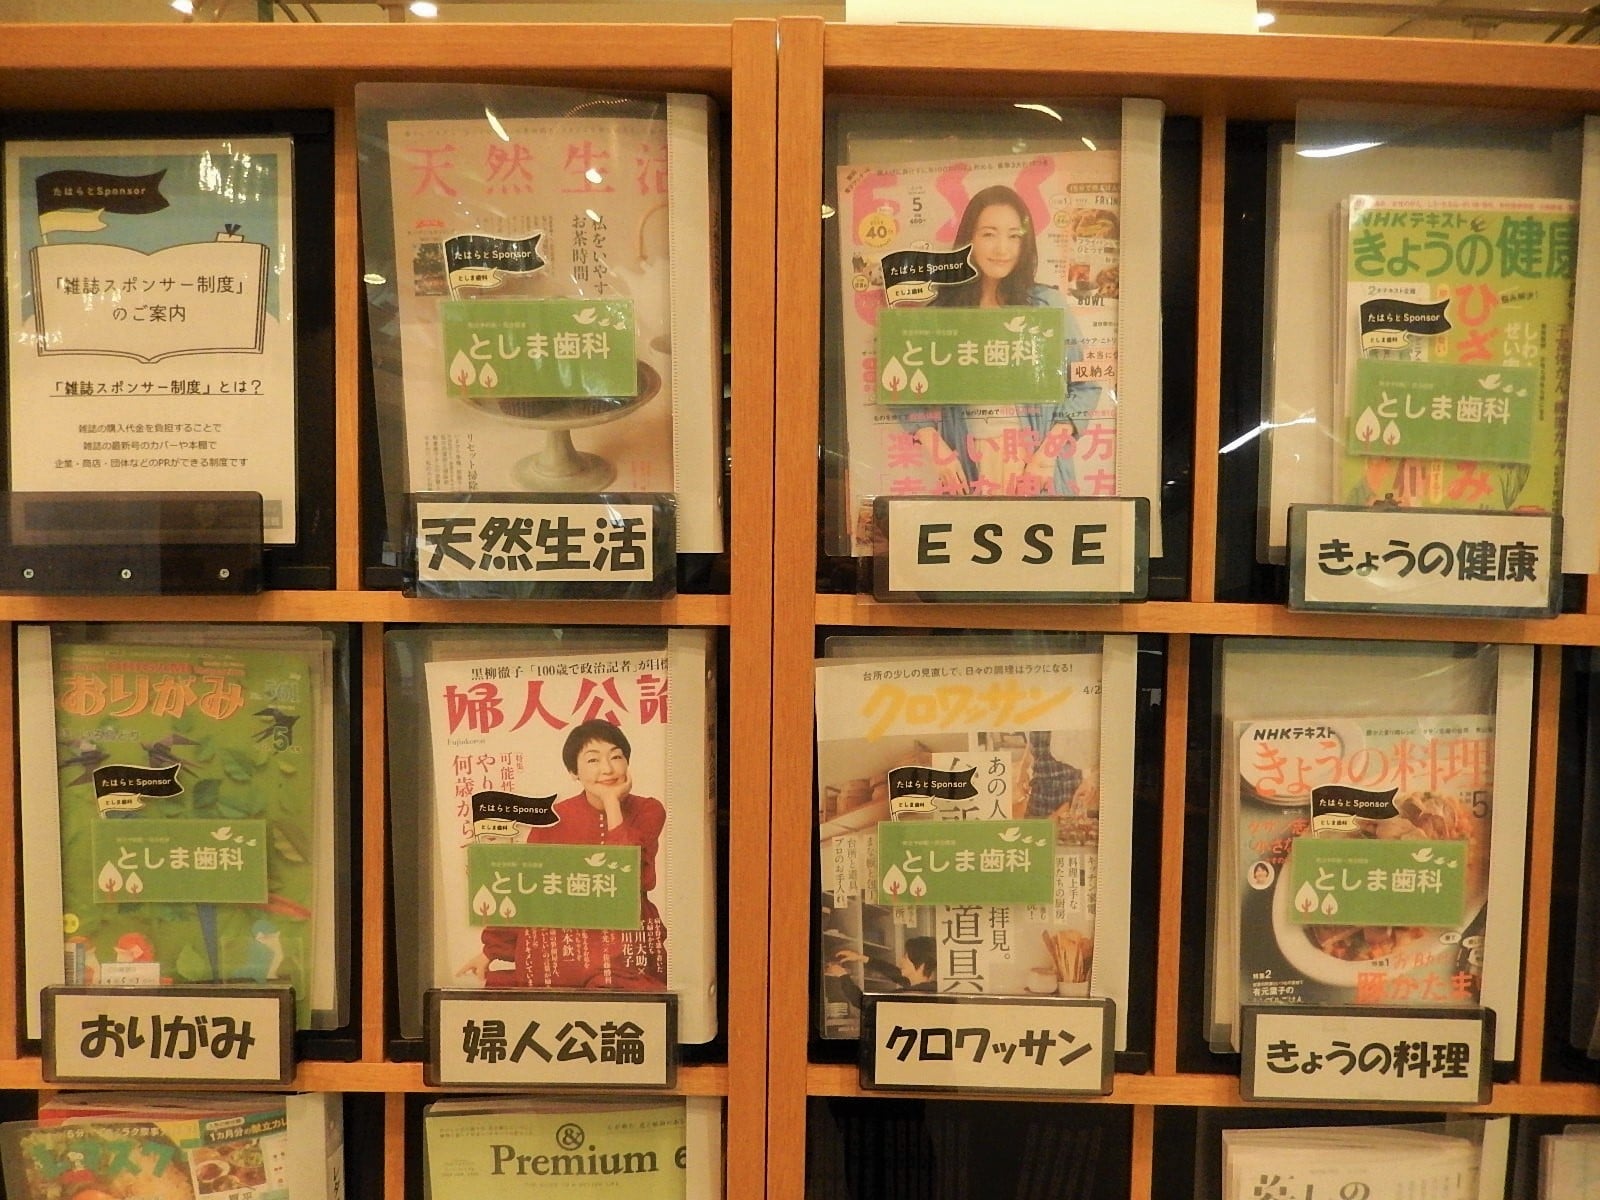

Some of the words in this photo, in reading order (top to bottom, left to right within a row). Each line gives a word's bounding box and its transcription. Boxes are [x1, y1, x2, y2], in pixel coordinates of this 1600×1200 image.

[912, 197, 924, 213] 5
[866, 225, 888, 239] 40
[572, 215, 588, 282] お茶時間
[55, 275, 244, 295] 「雑誌スポンサー制度」
[112, 304, 186, 323] のご案内
[469, 331, 611, 361] としま歯科
[902, 339, 1038, 366] としま歯科
[1376, 393, 1511, 424] としま歯科
[78, 423, 222, 433] 雑誌の購入代金を負担することで
[887, 424, 1117, 468] 楽しい貯め方
[421, 516, 647, 572] 天然生活
[917, 523, 1107, 566] ESSE
[1318, 538, 1539, 582] きょうの健康
[61, 672, 245, 721] おりがみ
[861, 678, 1074, 743] クロワッサン
[272, 725, 289, 751] 5
[1253, 726, 1337, 741] NHKテキスト
[1253, 738, 1493, 797] きょうの料理
[453, 754, 475, 848] 何歳から
[1472, 790, 1489, 818] 5
[118, 845, 243, 872] としま歯科
[902, 848, 1032, 873] としま歯科
[491, 870, 617, 898] としま歯科
[1315, 867, 1443, 894] としま歯科
[941, 904, 986, 993] 道具
[80, 1014, 256, 1061] おりがみ
[462, 1020, 645, 1065] 婦人公論
[885, 1025, 1093, 1066] クロワッサン
[1266, 1040, 1470, 1079] きょうの料理
[490, 1144, 660, 1176] Premium
